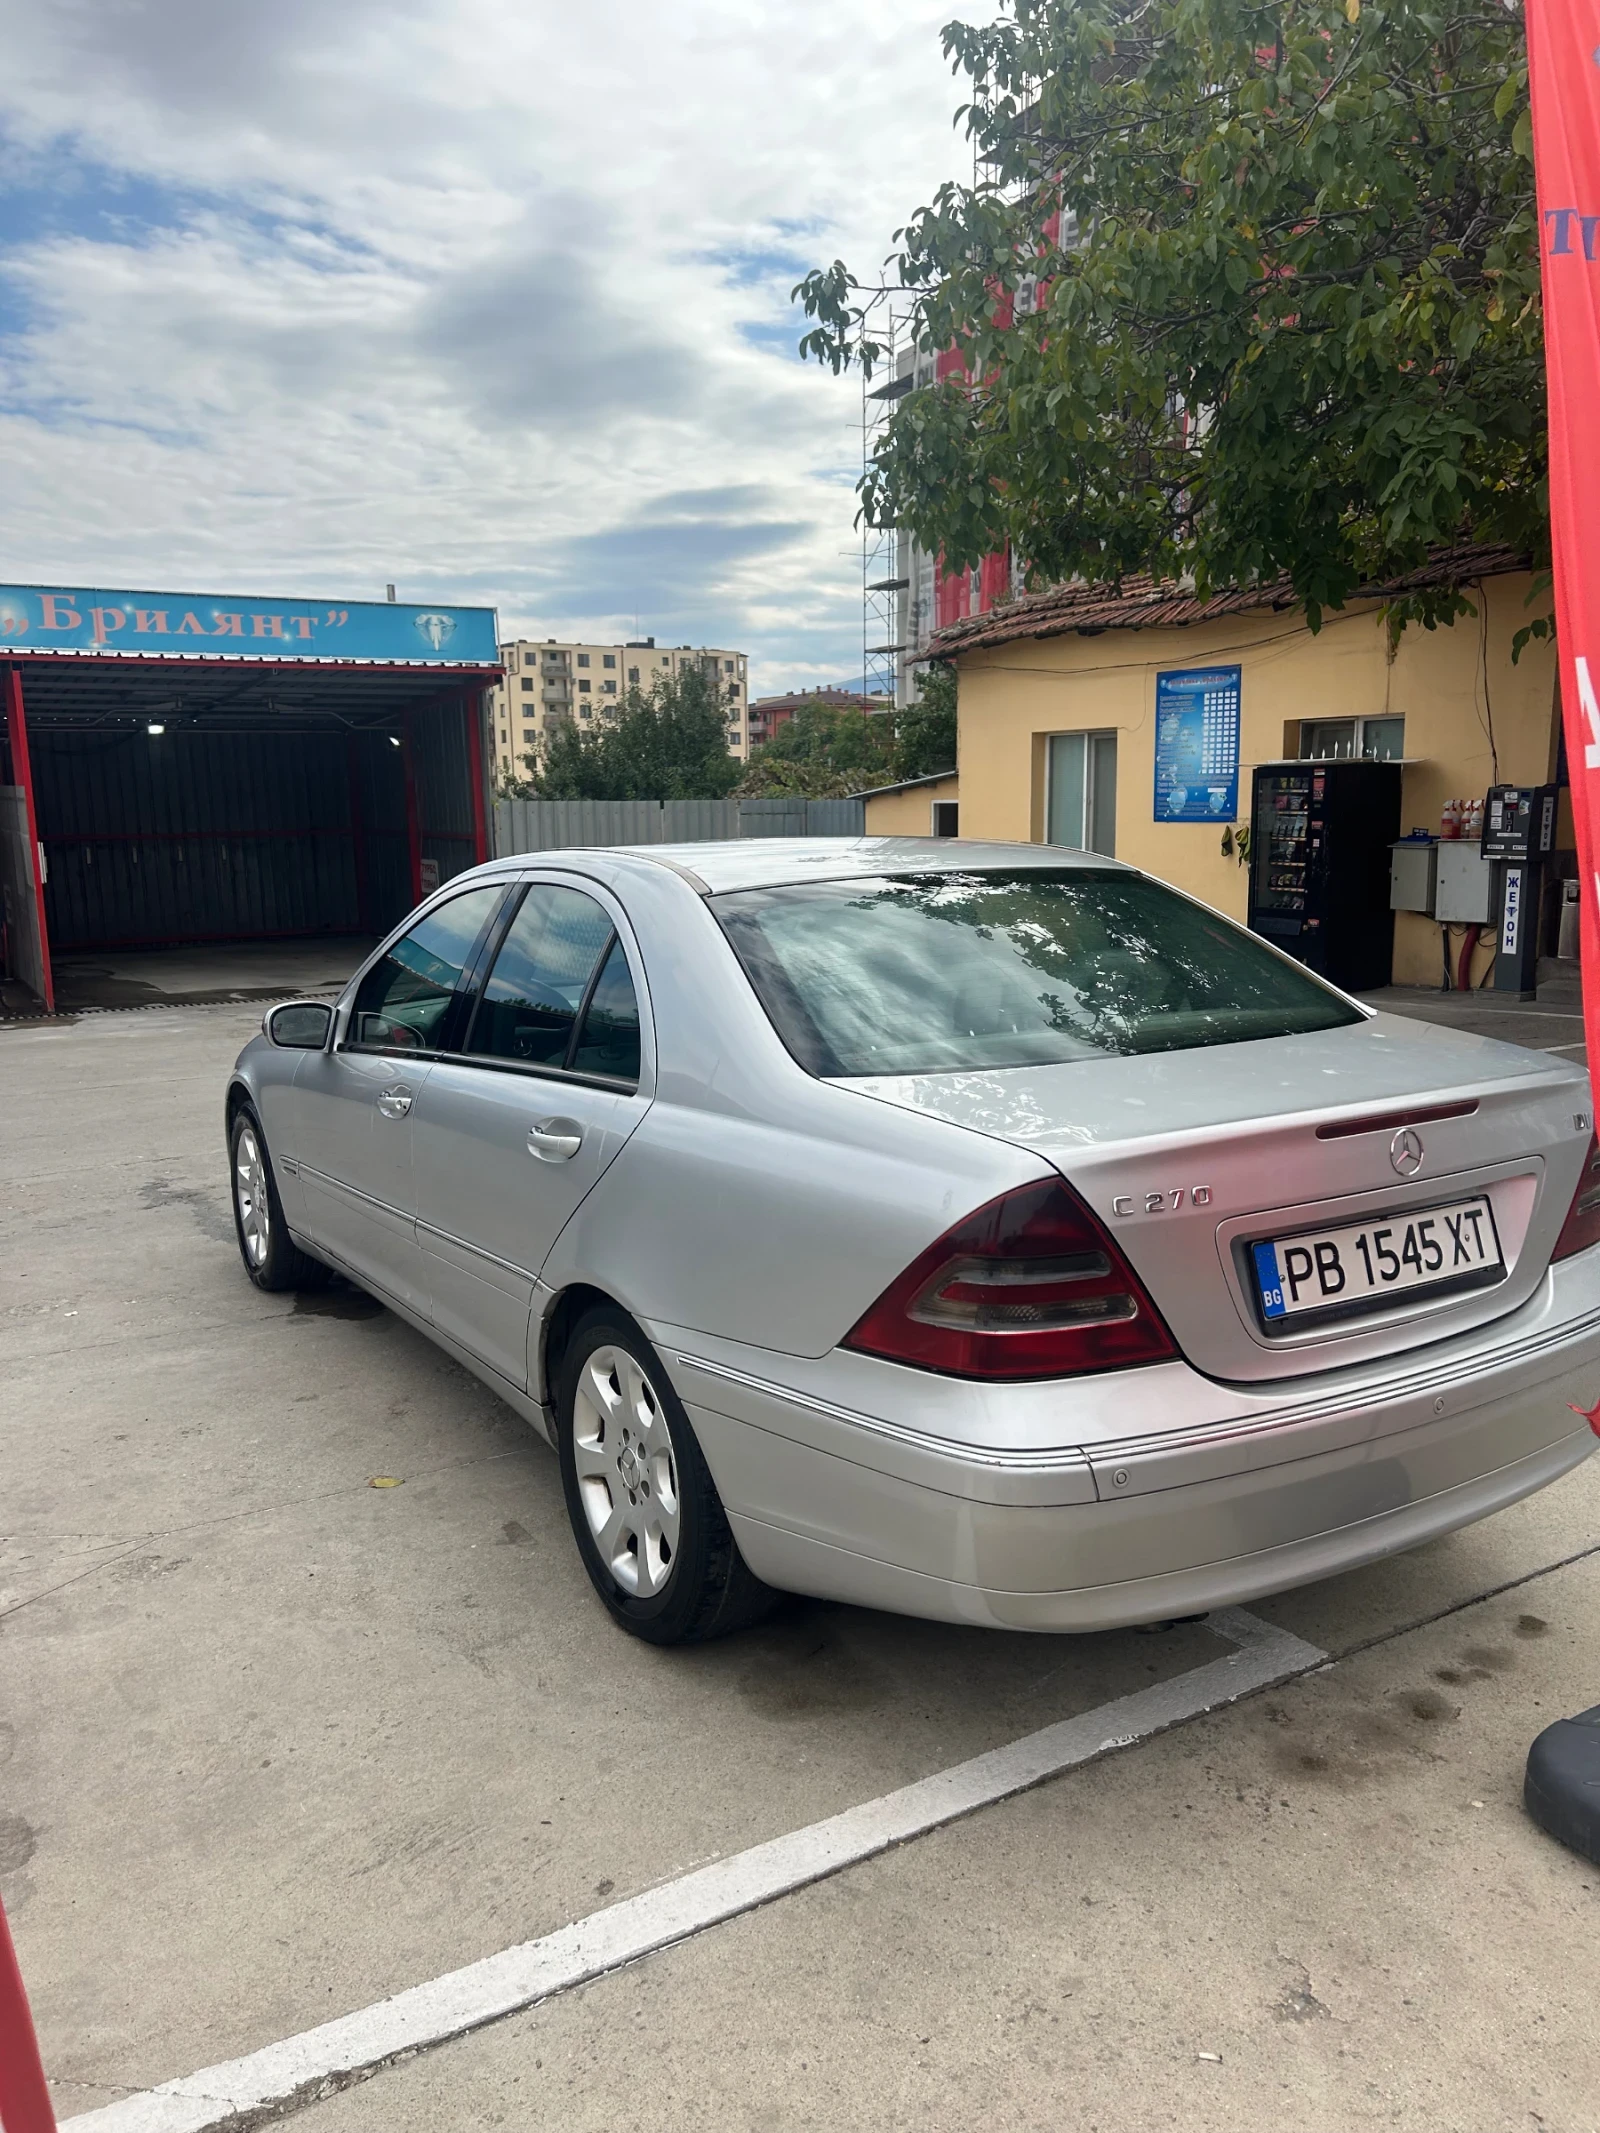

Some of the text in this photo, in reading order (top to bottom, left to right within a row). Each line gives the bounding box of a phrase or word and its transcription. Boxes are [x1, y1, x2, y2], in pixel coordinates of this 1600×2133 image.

[1505, 877, 1519, 946] ЖЕТОН
[1112, 1185, 1213, 1217] C 270
[1284, 1209, 1485, 1301] PB 1545 XT
[1263, 1289, 1282, 1307] BG
